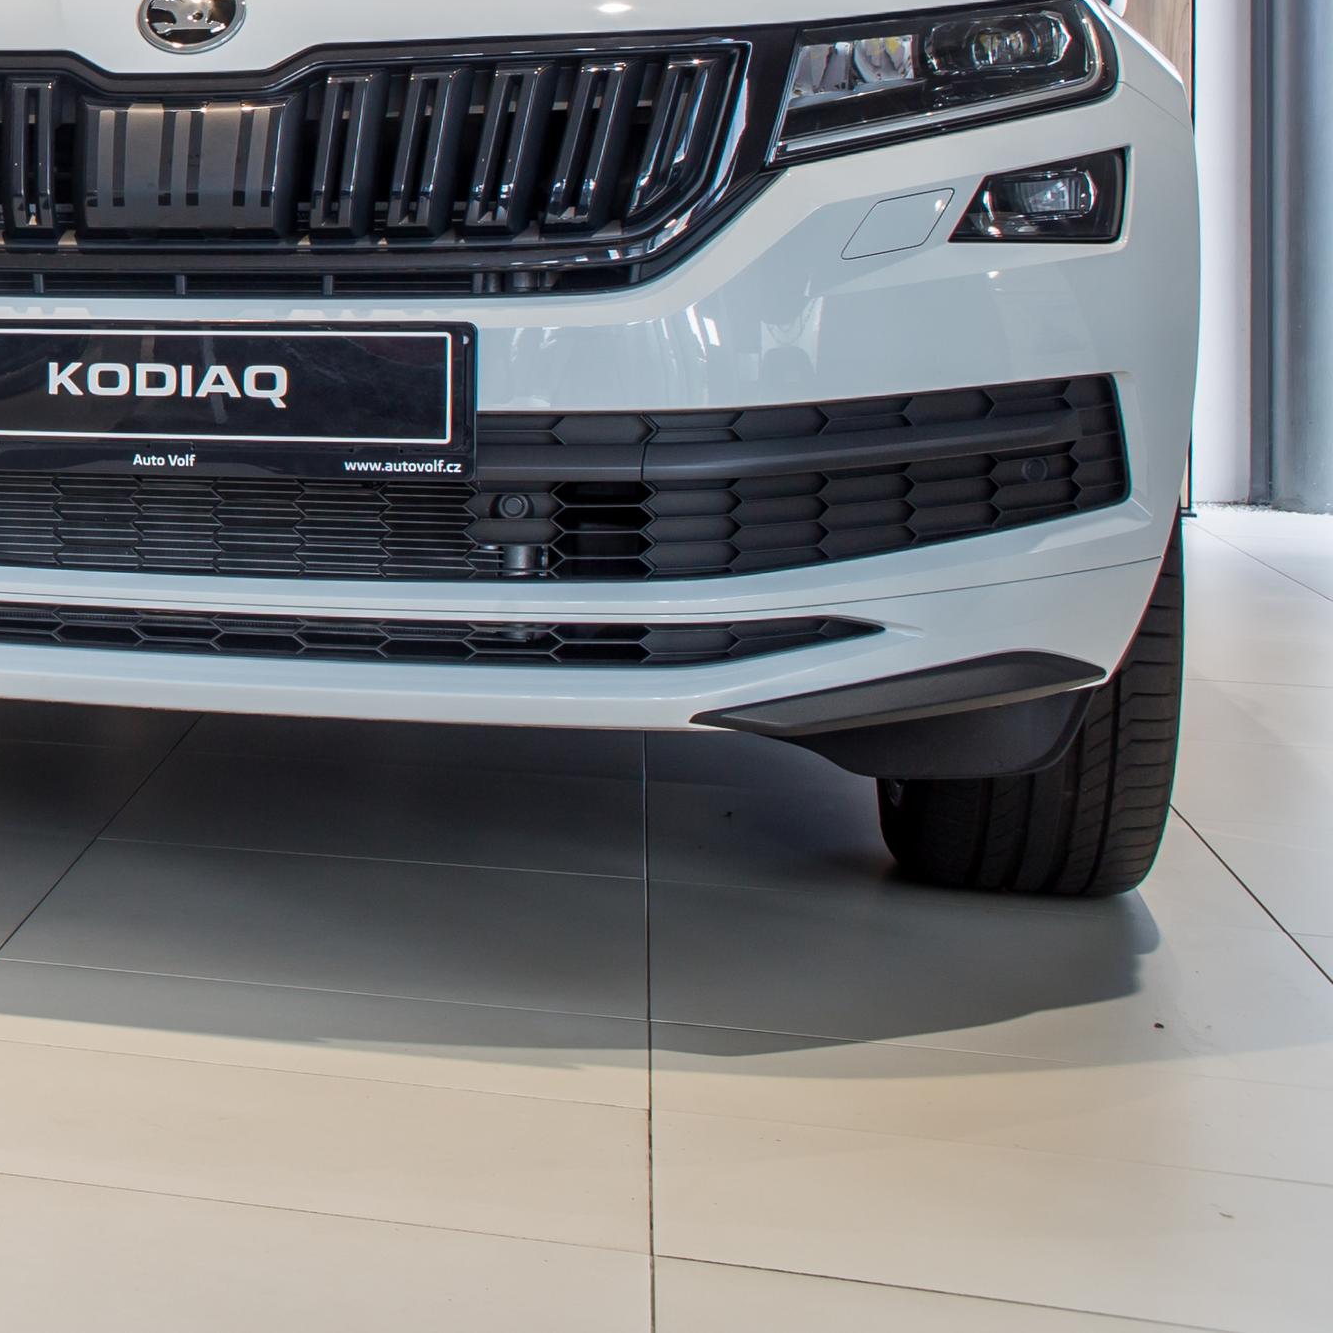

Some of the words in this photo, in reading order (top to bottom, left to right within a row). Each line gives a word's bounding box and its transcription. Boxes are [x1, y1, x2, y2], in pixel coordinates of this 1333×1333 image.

[48, 362, 288, 409] KODIAQ
[132, 454, 165, 467] Auto
[168, 453, 196, 467] Volf
[344, 459, 462, 474] www.autovolf.cz
